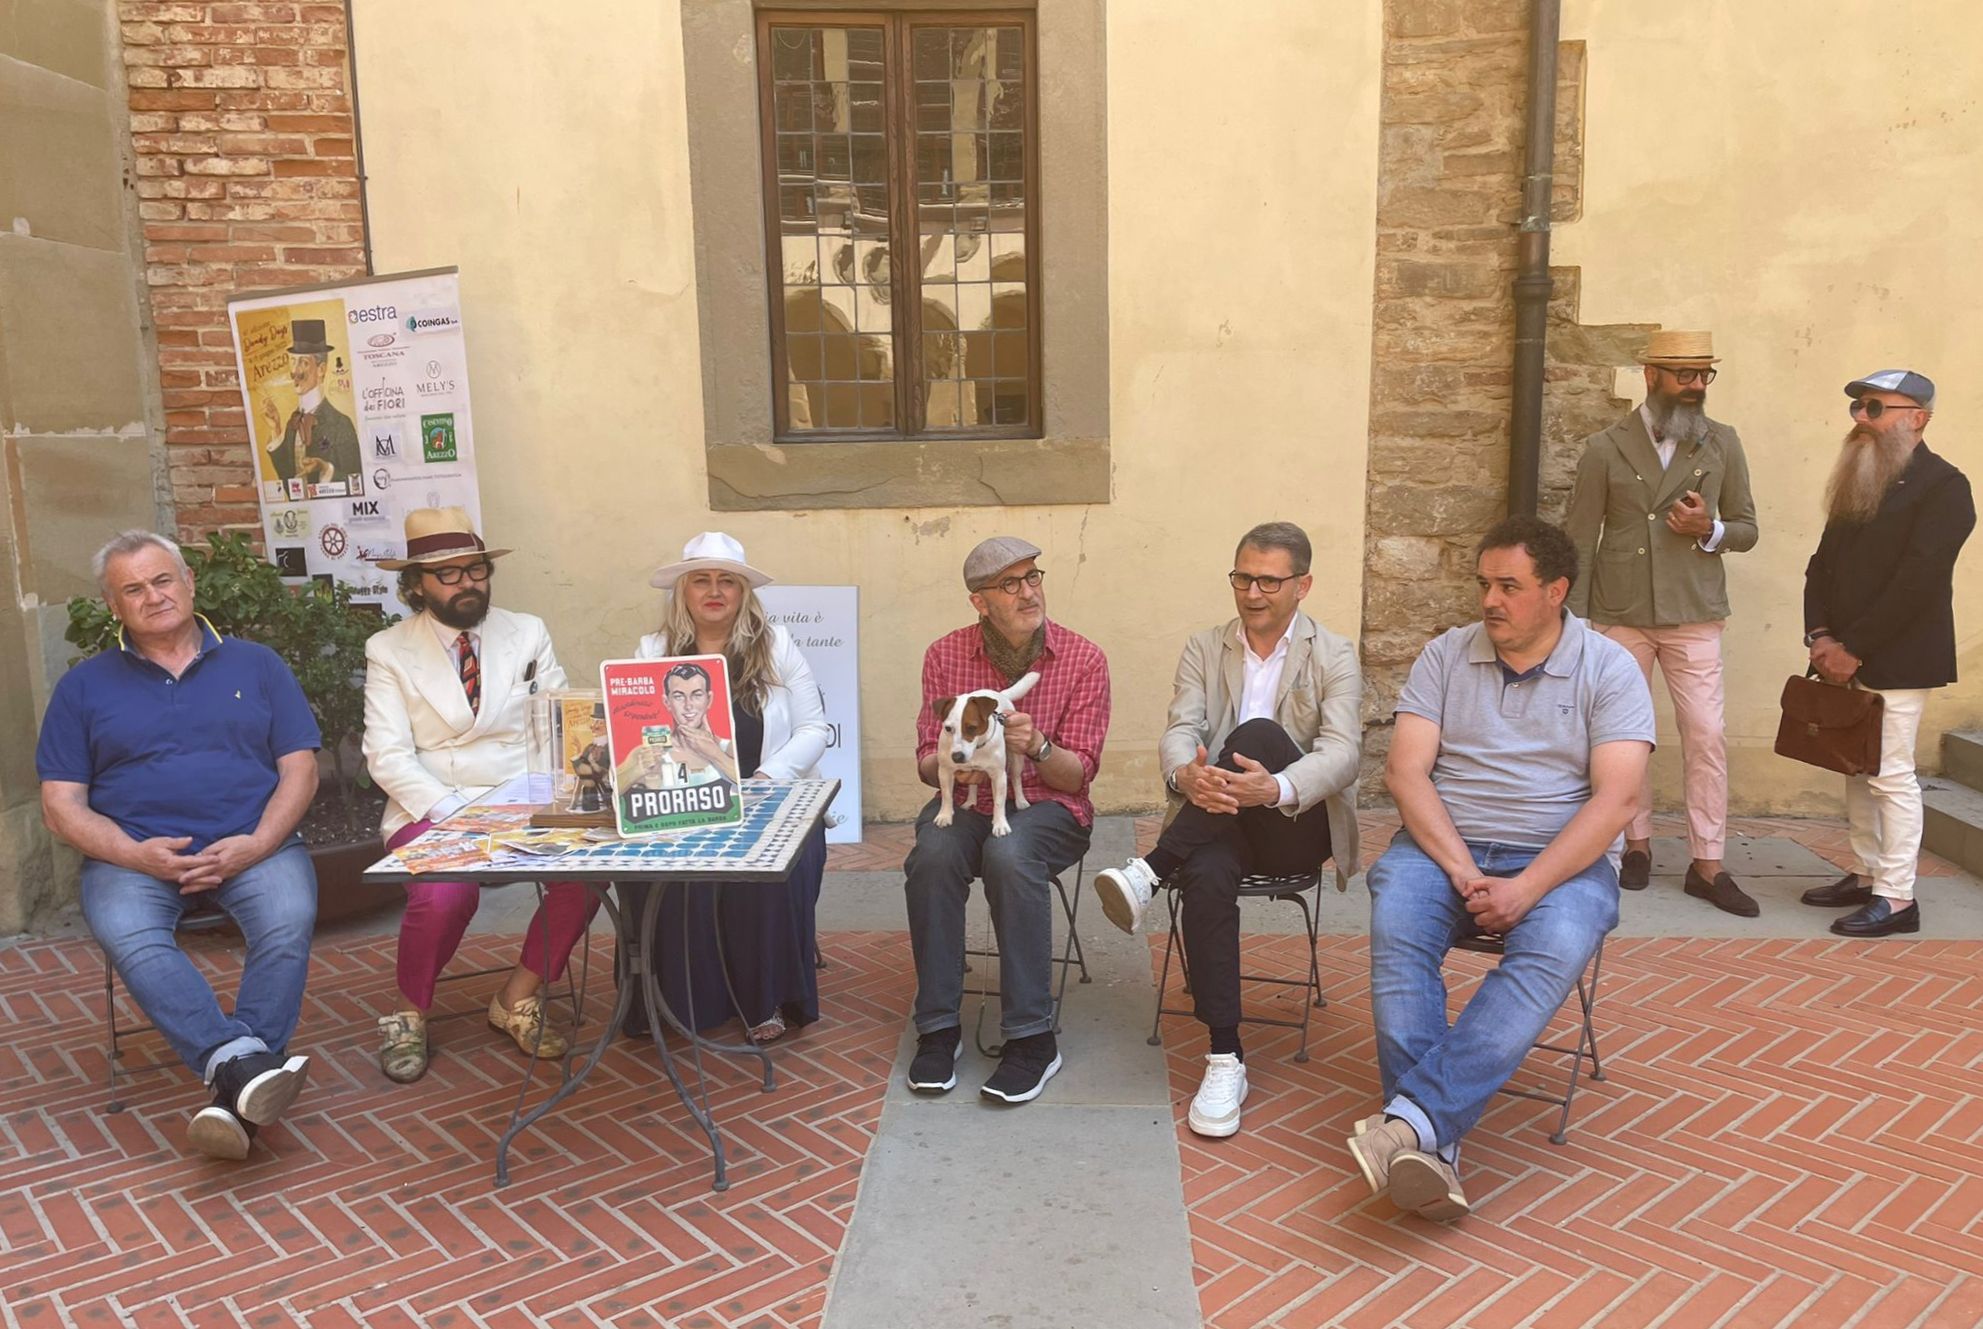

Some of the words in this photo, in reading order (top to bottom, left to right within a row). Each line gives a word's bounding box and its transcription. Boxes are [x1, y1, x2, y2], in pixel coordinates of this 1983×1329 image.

[418, 316, 450, 328] COINGAS
[364, 351, 405, 360] TOSCANA
[253, 353, 289, 382] Arezzo
[416, 379, 456, 393] MELY'S
[377, 398, 405, 411] FIORI
[352, 500, 379, 516] MIX
[783, 611, 810, 624] vita
[814, 611, 825, 624] è
[806, 635, 845, 647] tante
[610, 676, 654, 686] PRE-BARBA
[611, 686, 656, 696] MIRACOLO
[677, 762, 688, 783] 4
[631, 785, 726, 817] PRORASO
